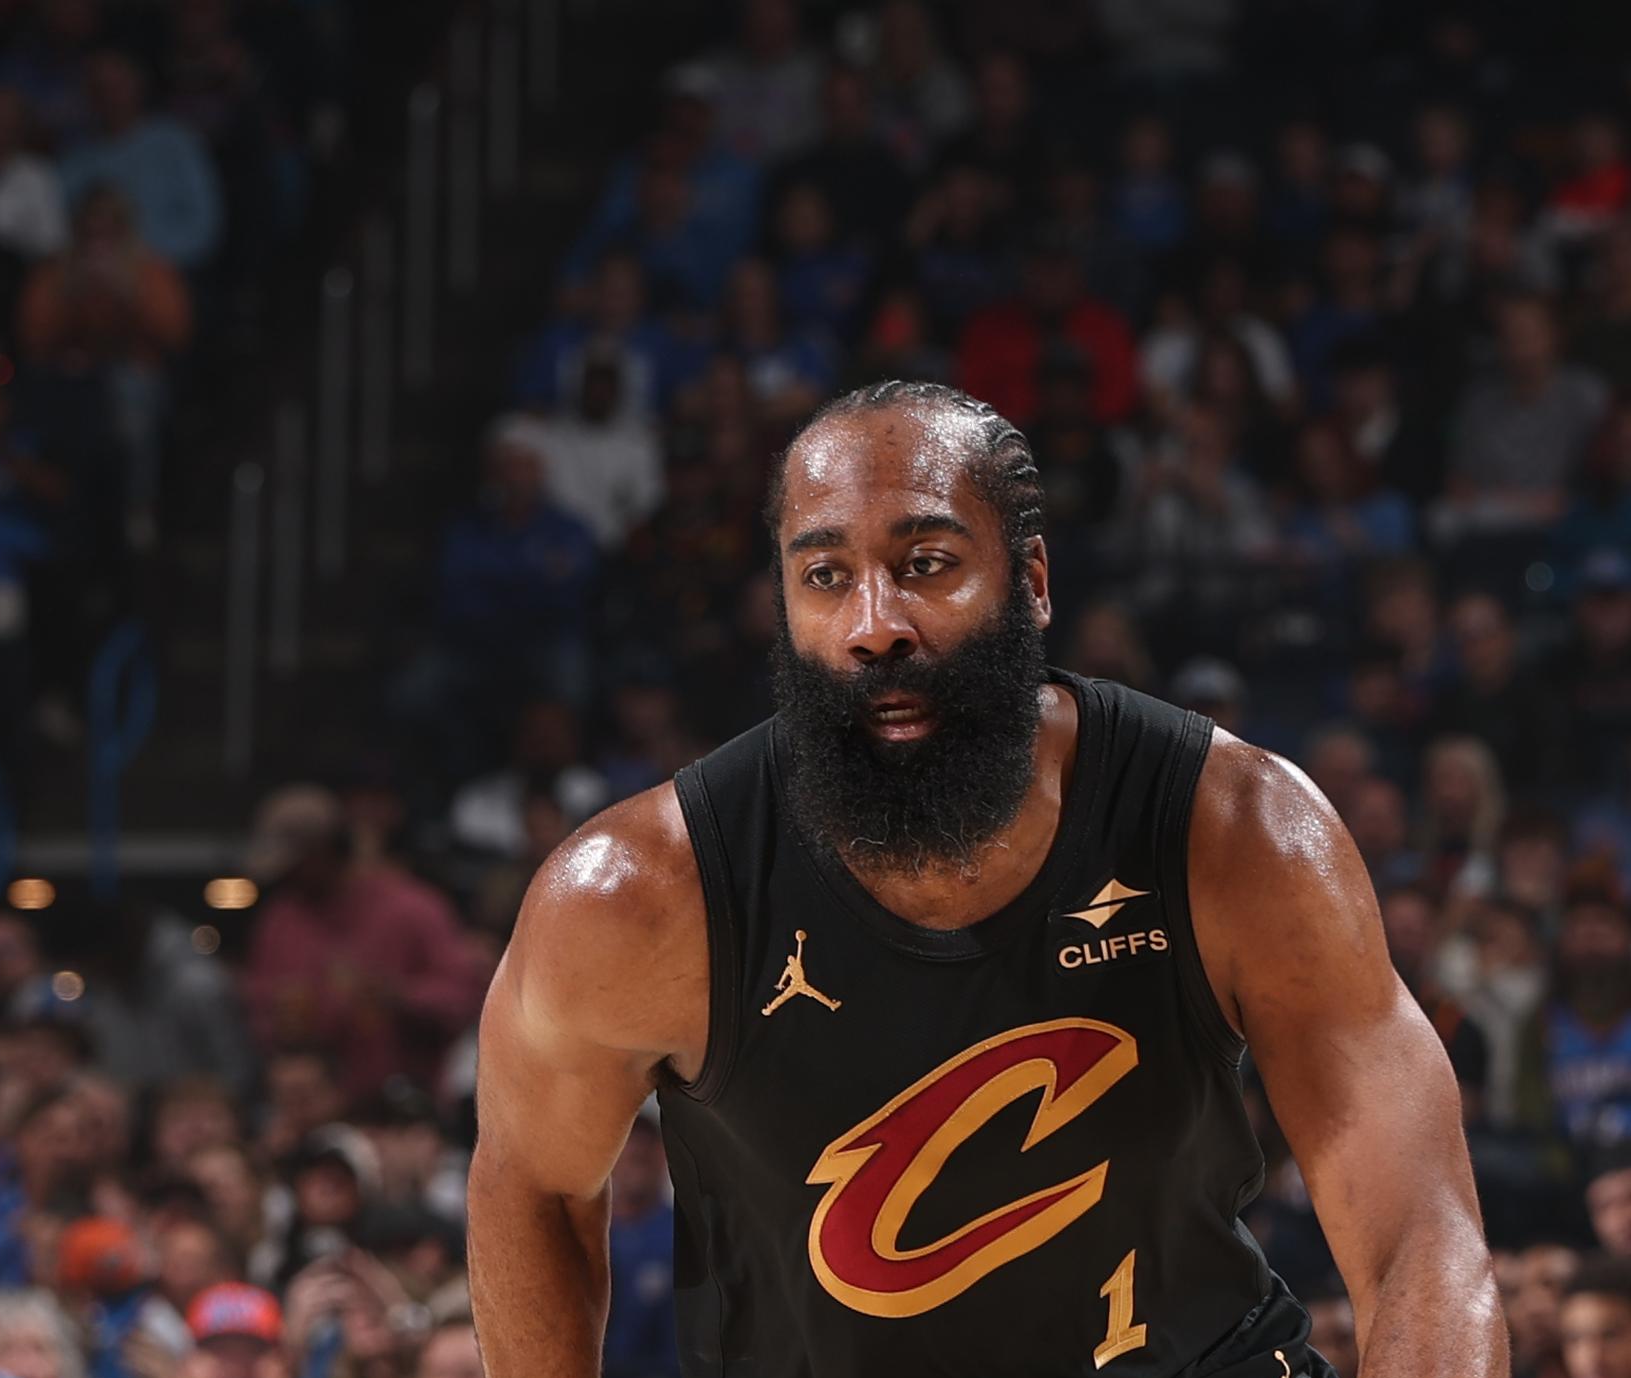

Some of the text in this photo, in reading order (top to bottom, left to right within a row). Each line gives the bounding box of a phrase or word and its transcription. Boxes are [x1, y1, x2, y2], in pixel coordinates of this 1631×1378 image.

[1058, 929, 1169, 969] CLIFFS
[805, 1016, 1139, 1319] C
[1093, 1248, 1147, 1370] 1
